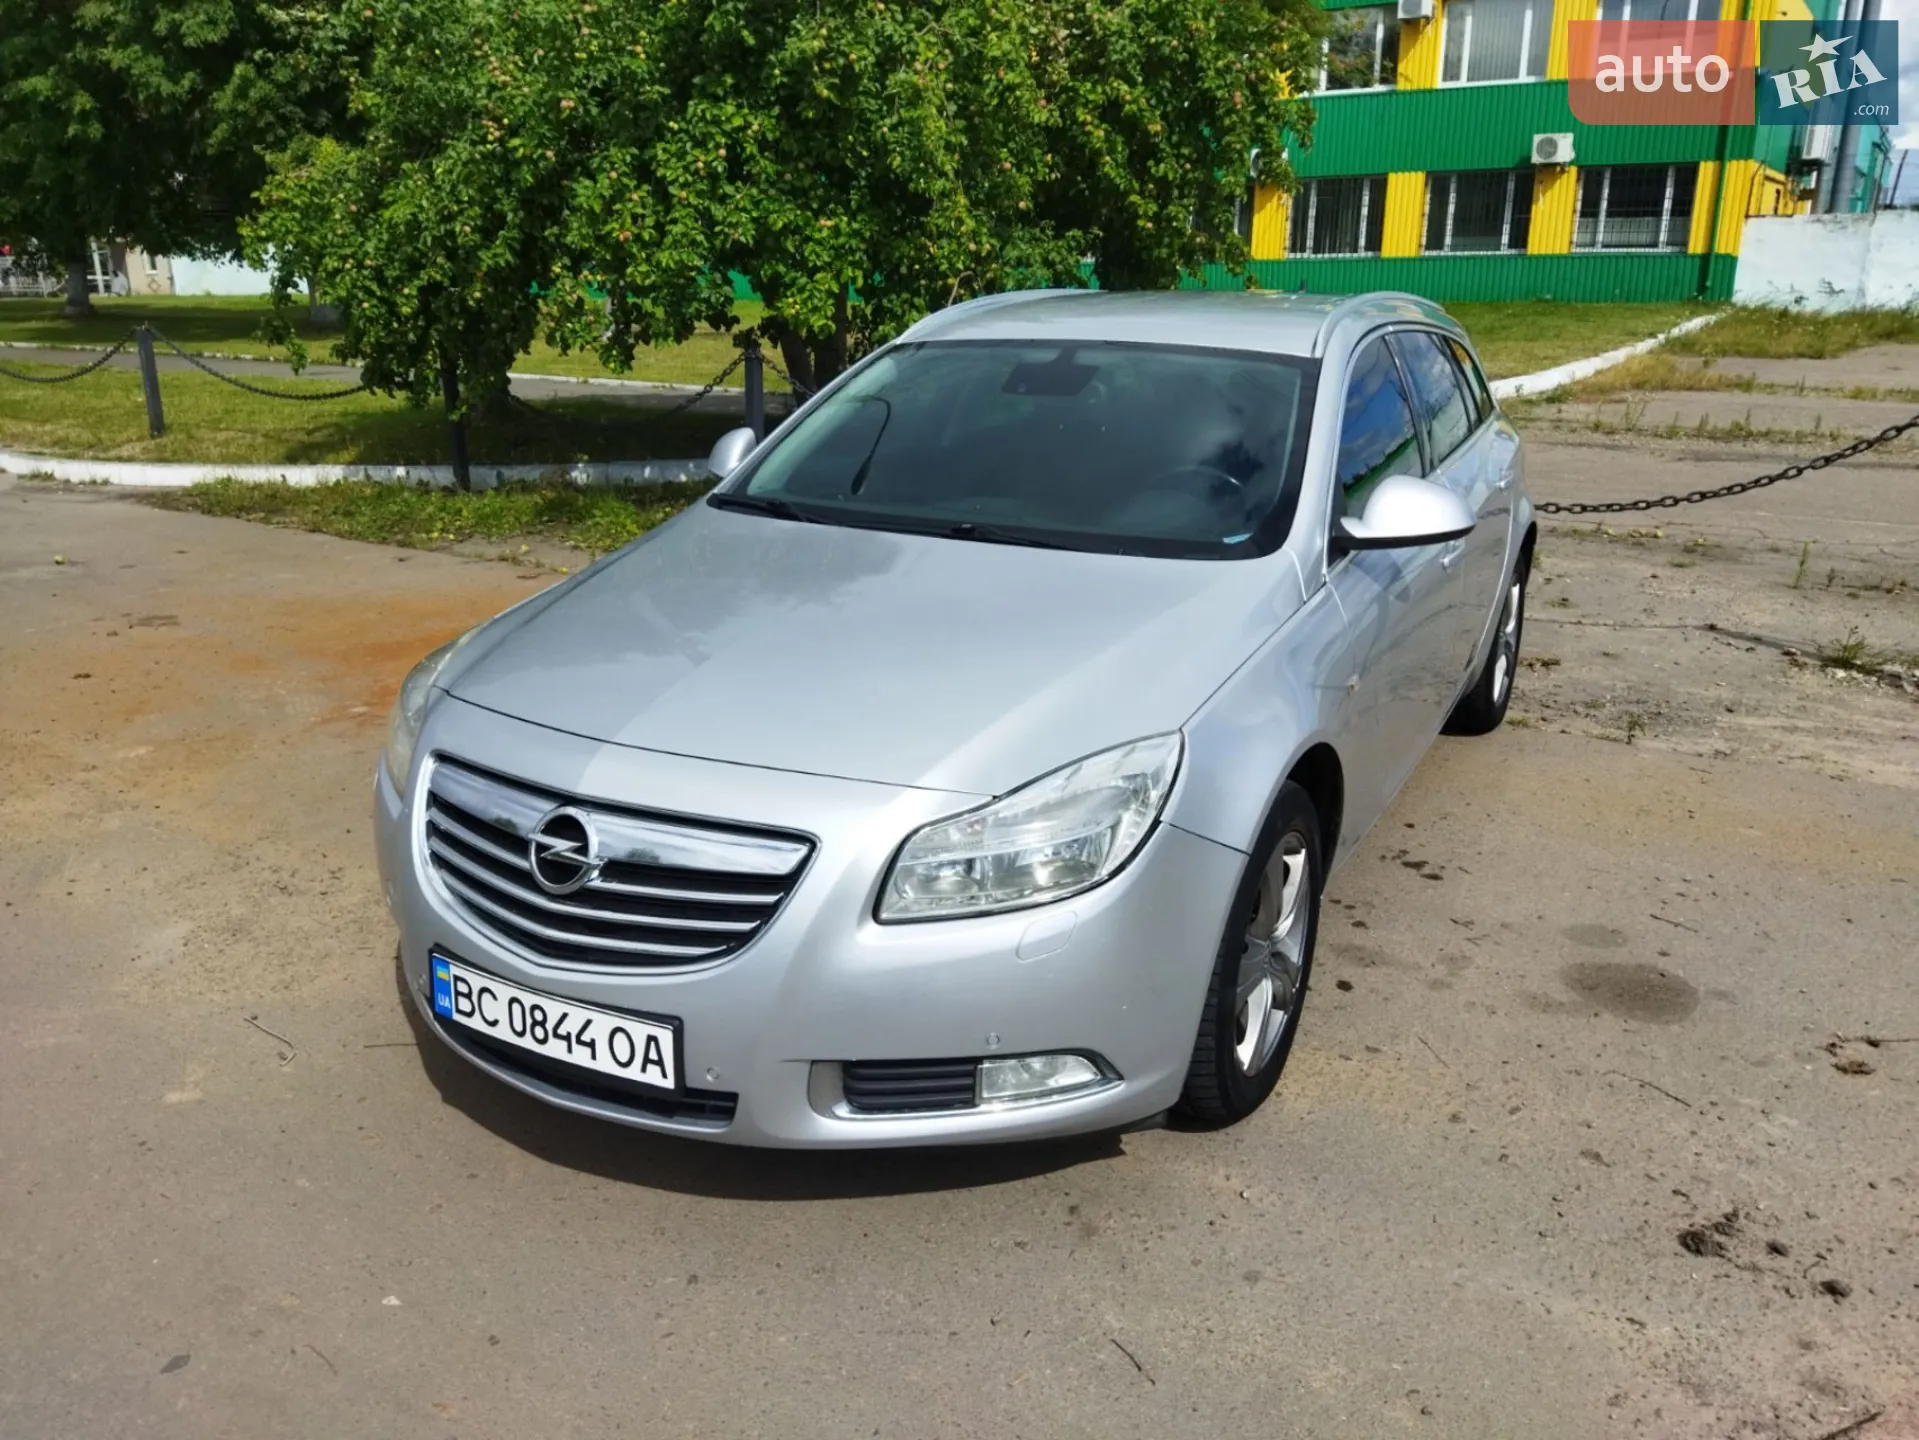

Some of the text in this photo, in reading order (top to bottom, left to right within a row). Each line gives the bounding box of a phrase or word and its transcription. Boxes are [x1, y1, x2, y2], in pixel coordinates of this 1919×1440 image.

[437, 993, 451, 1009] UA
[452, 974, 668, 1079] BC 0844 OA
